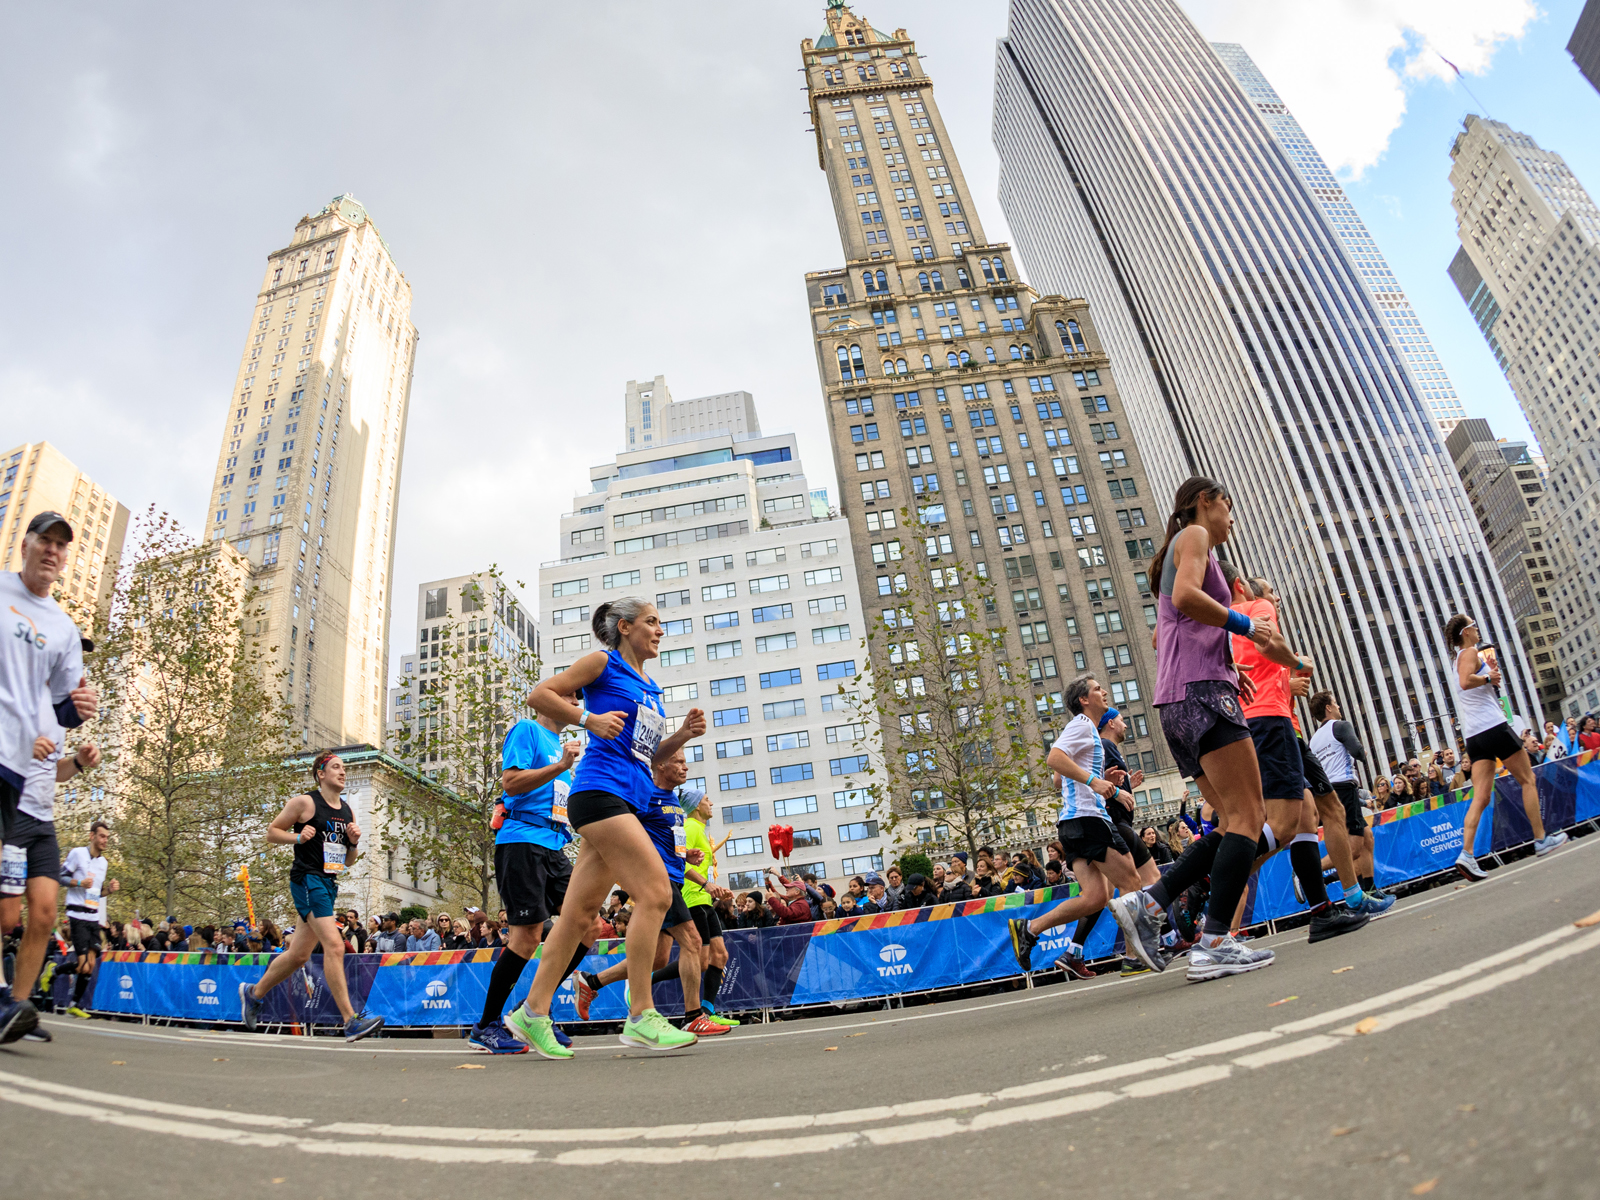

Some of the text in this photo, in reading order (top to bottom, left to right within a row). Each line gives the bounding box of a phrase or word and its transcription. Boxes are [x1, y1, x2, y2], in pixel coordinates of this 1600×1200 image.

[13, 622, 47, 650] SLG
[326, 821, 347, 833] NEW
[1431, 821, 1453, 834] TATA
[322, 831, 345, 843] YOR
[1420, 827, 1464, 847] CONSULTANC
[1430, 838, 1462, 854] SERVICES
[1038, 936, 1071, 951] TATA
[877, 963, 913, 977] TATA
[727, 966, 740, 994] MARATHON
[197, 995, 219, 1005] TATA
[421, 1000, 451, 1009] TATA
[558, 994, 575, 1004] TA
